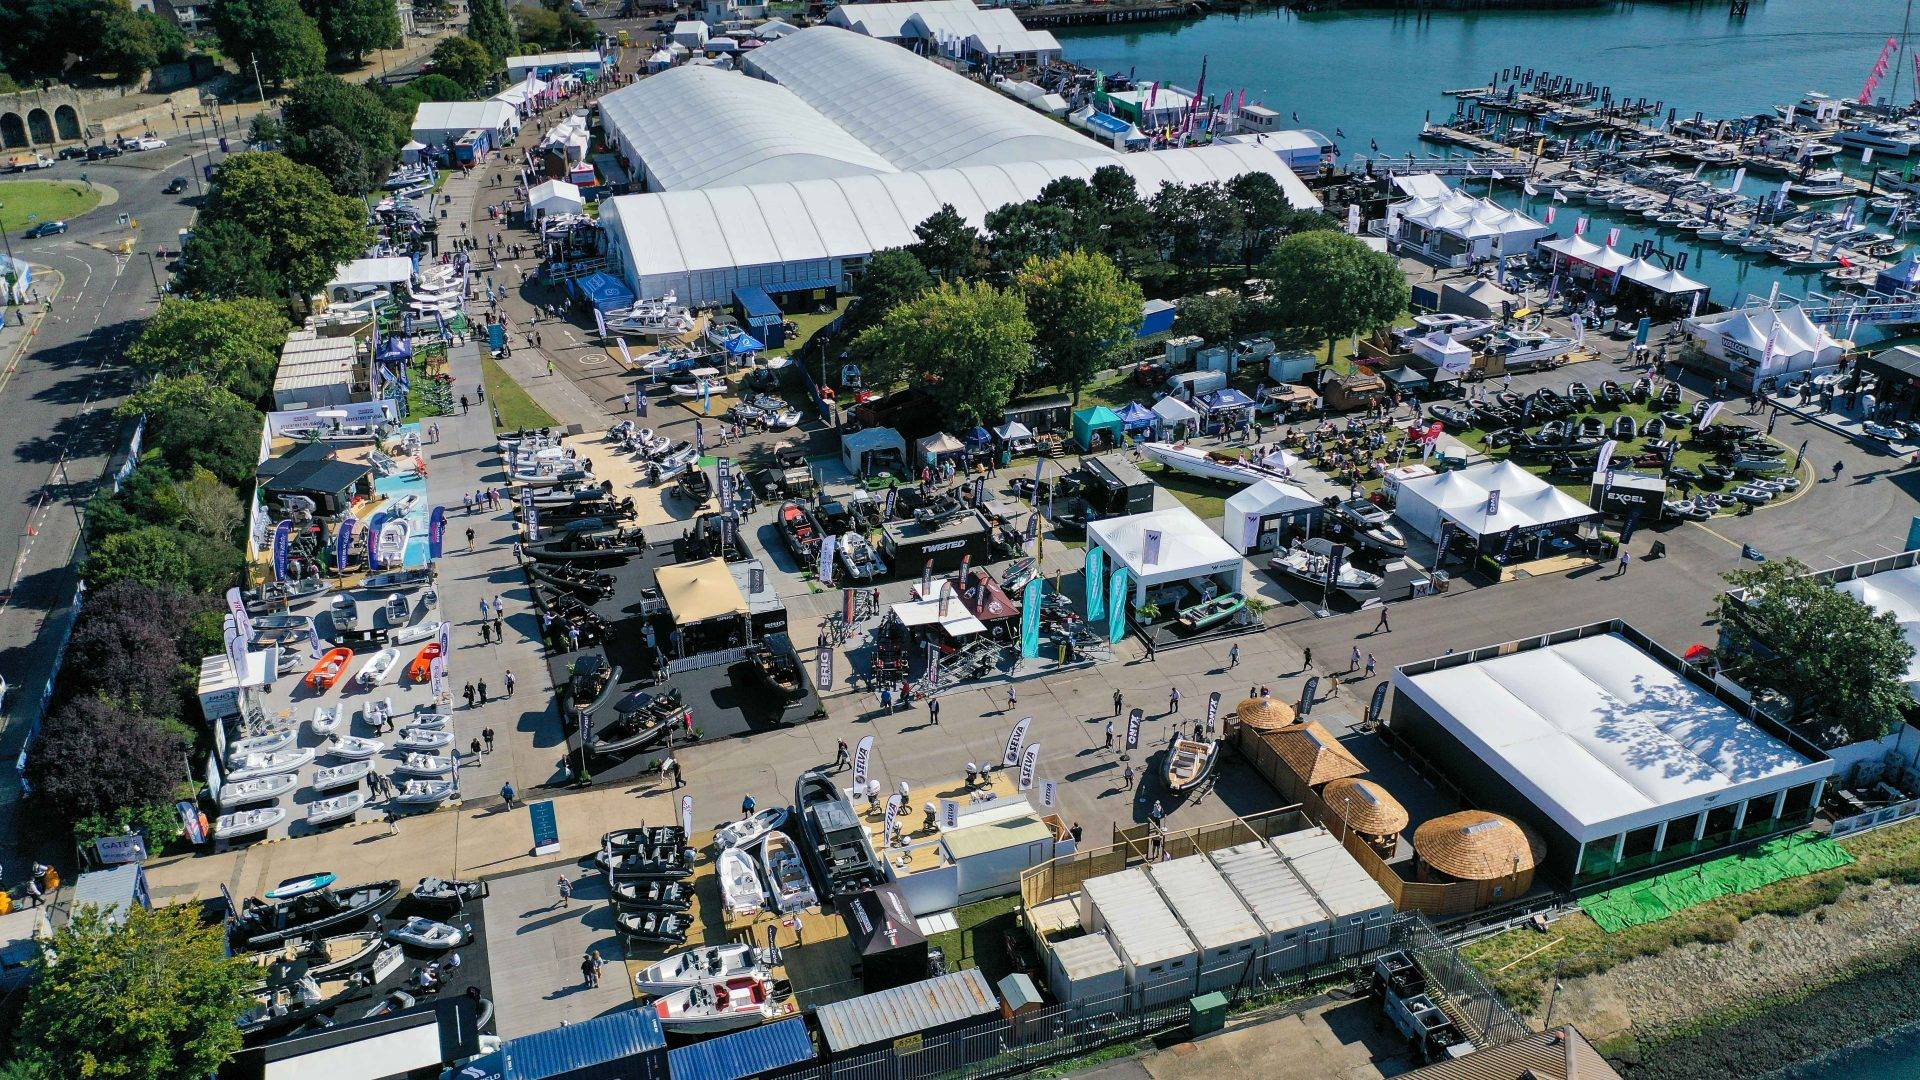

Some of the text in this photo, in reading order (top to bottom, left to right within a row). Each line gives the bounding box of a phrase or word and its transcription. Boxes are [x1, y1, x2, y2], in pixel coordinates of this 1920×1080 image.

[1607, 492, 1646, 505] EXCEL
[529, 510, 537, 541] BRIG
[1518, 523, 1545, 534] CONCEPT
[1546, 519, 1568, 529] MARINE
[1569, 516, 1589, 524] GROUP
[922, 539, 967, 554] TWISTED
[821, 652, 829, 685] BRIG
[1209, 698, 1217, 727] ONYX
[1010, 726, 1024, 752] SELVA
[1128, 714, 1139, 745] ONYX
[857, 747, 867, 776] SELVA
[1022, 752, 1035, 777] SELVA
[102, 841, 129, 849] GATE
